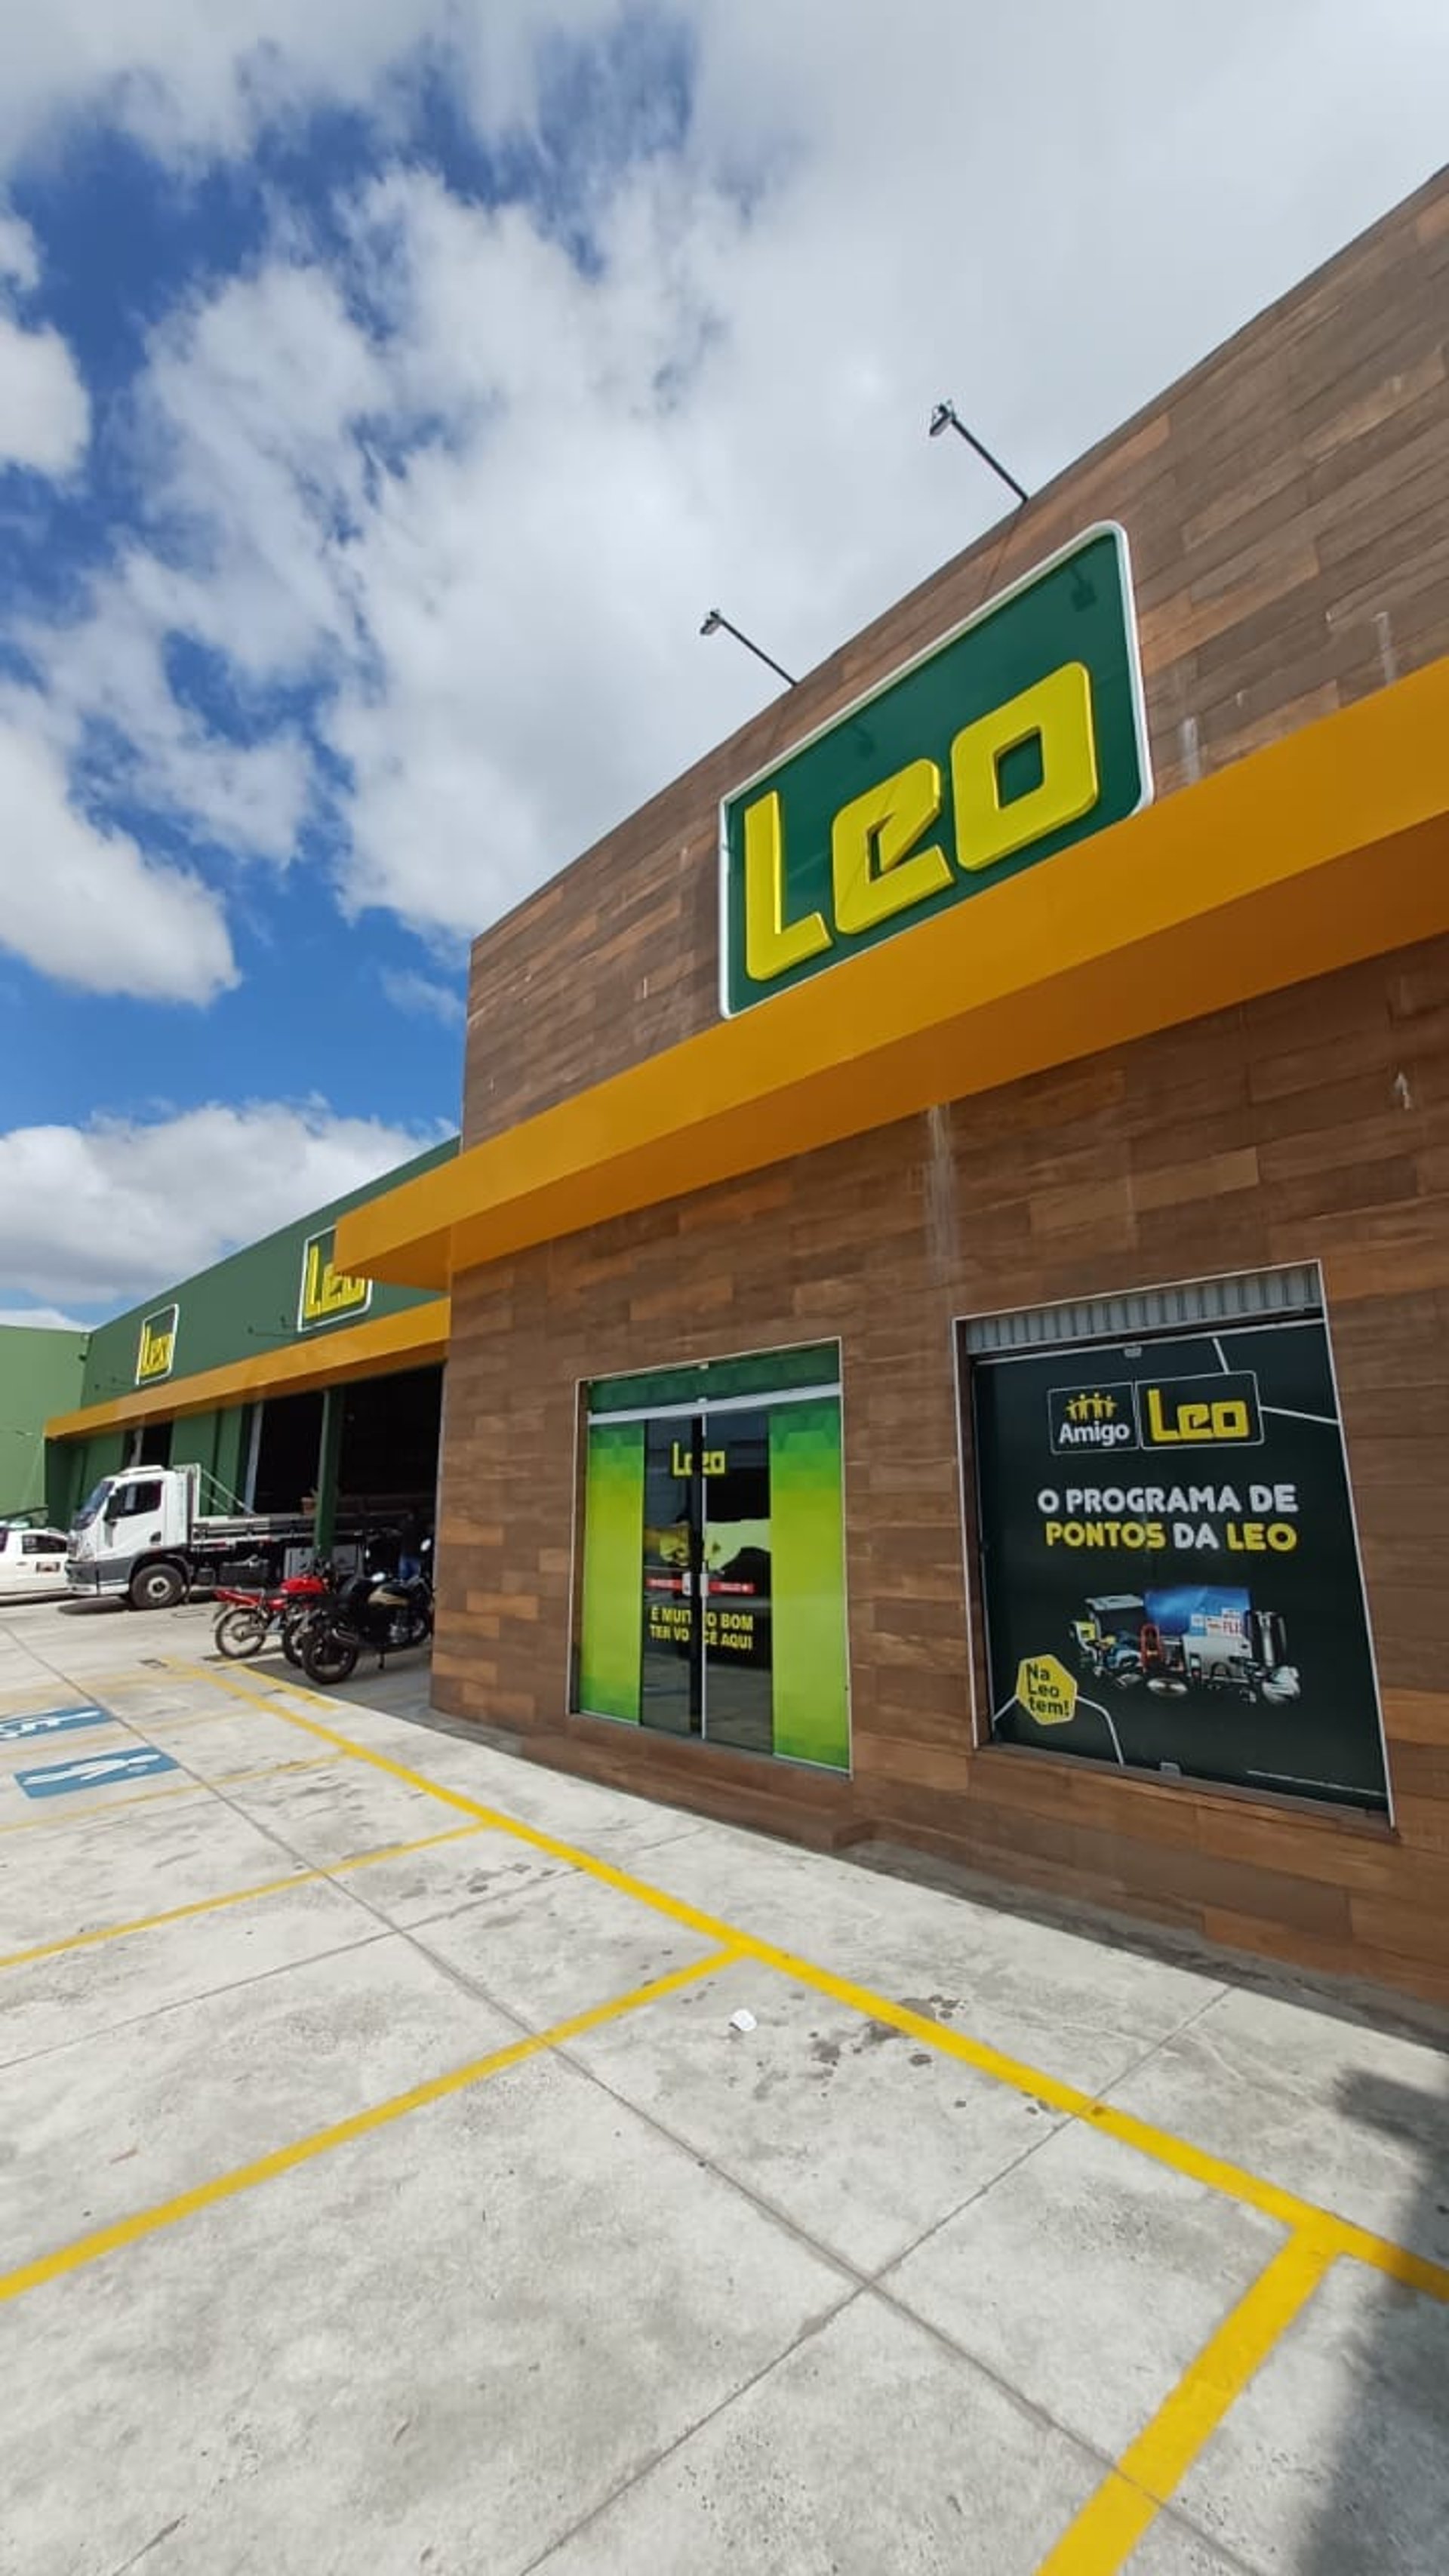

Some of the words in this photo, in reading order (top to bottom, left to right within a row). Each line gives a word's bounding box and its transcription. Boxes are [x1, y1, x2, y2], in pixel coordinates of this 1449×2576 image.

[743, 661, 1098, 980] Leo
[1148, 1388, 1249, 1442] Leo
[1059, 1420, 1130, 1446] Amigo
[1038, 1489, 1060, 1513] O
[1066, 1485, 1242, 1513] PROGRAMA
[1249, 1485, 1299, 1512] DE
[1046, 1522, 1166, 1548] PONTOS
[1173, 1523, 1220, 1549] DA
[1226, 1522, 1297, 1551] LEO
[721, 1613, 753, 1631] BOM
[651, 1623, 671, 1641] TER
[721, 1632, 752, 1650] AQUI
[1026, 1663, 1050, 1681] Na
[1028, 1676, 1059, 1698] Leo
[1029, 1696, 1069, 1717] tem!
